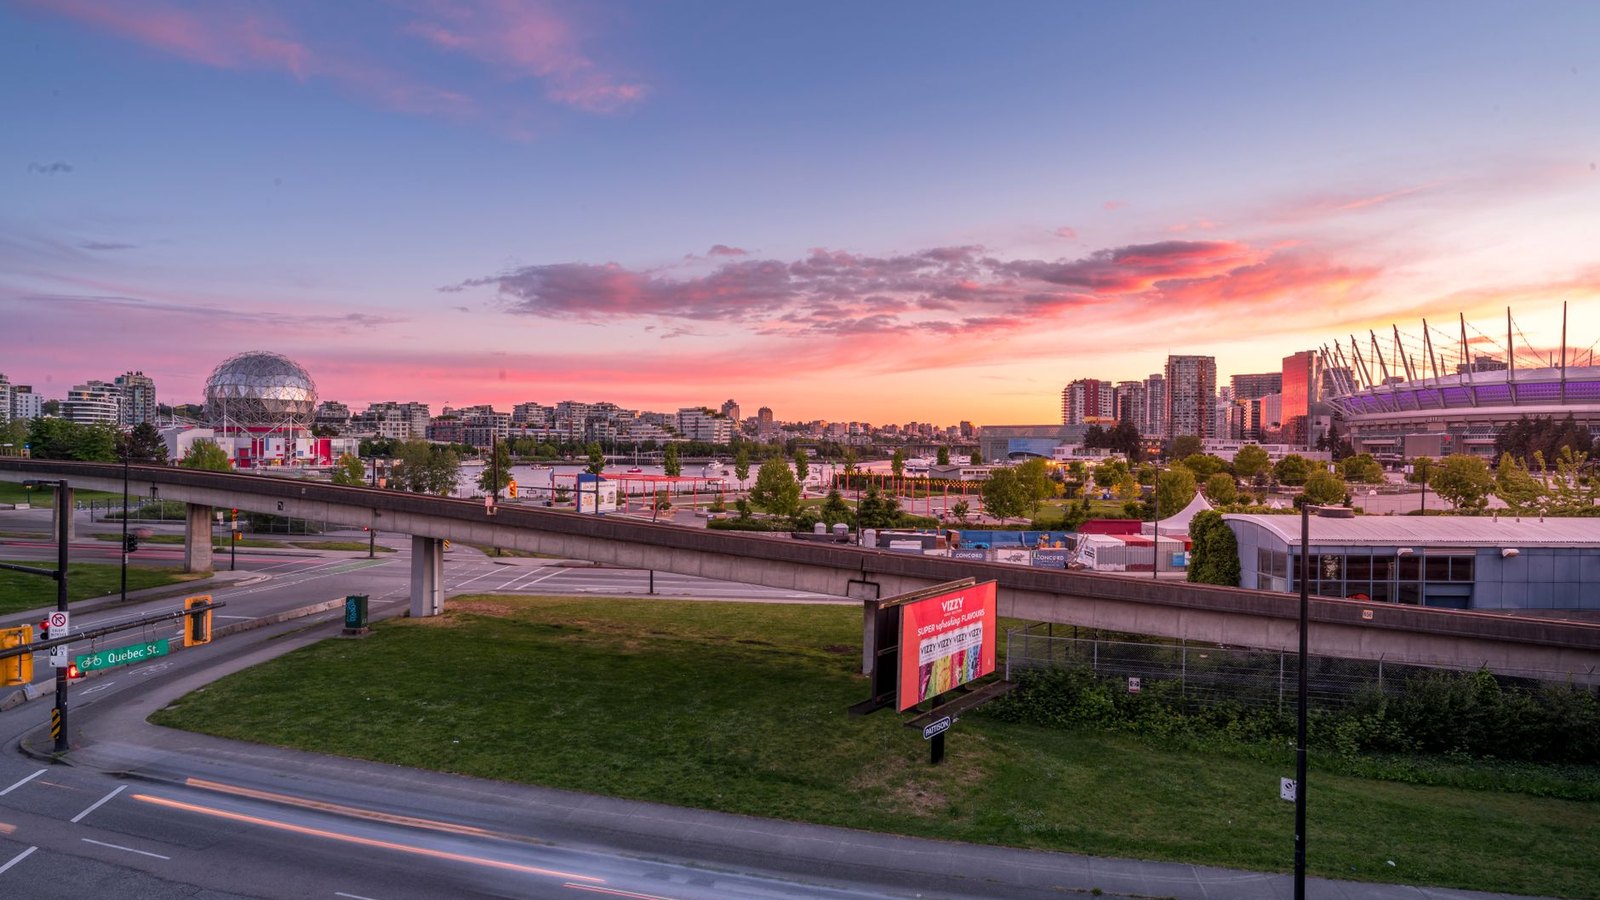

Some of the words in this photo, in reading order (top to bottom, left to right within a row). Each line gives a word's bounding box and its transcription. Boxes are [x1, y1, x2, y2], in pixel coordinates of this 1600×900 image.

[941, 597, 964, 612] VIZZY
[917, 622, 935, 637] SUPER
[961, 608, 985, 622] FLAVOURS
[953, 633, 967, 644] VIZZY
[968, 628, 982, 638] VIZZY
[920, 642, 937, 655] VIZZY
[937, 637, 953, 649] VIZZY
[107, 648, 144, 664] Quebec
[146, 645, 159, 655] St.
[925, 719, 949, 737] PATTISON
